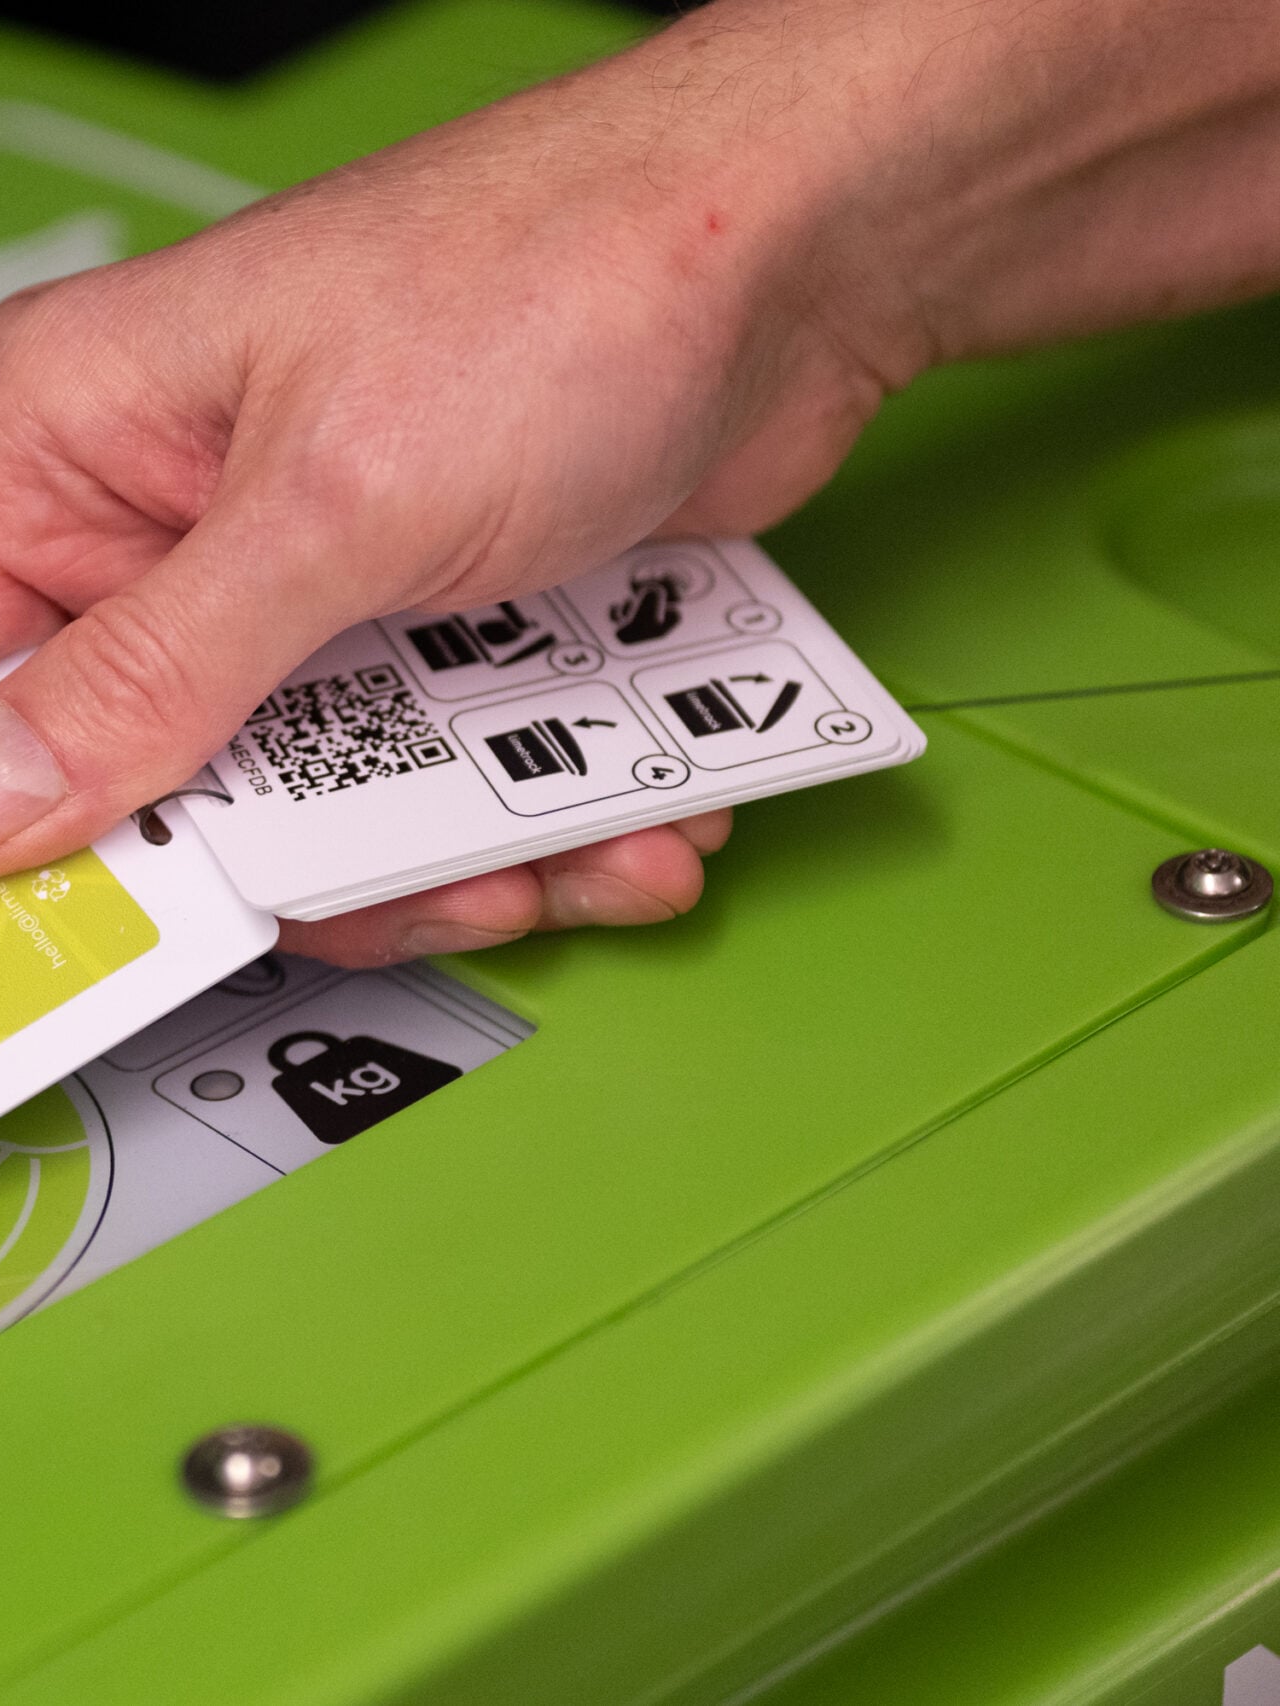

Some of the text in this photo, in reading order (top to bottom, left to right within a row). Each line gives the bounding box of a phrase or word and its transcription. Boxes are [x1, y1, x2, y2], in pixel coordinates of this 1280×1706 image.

[743, 612, 765, 625] 1
[564, 651, 590, 667] 3
[830, 720, 857, 736] 2
[650, 766, 675, 781] 4
[310, 1062, 401, 1106] kg
